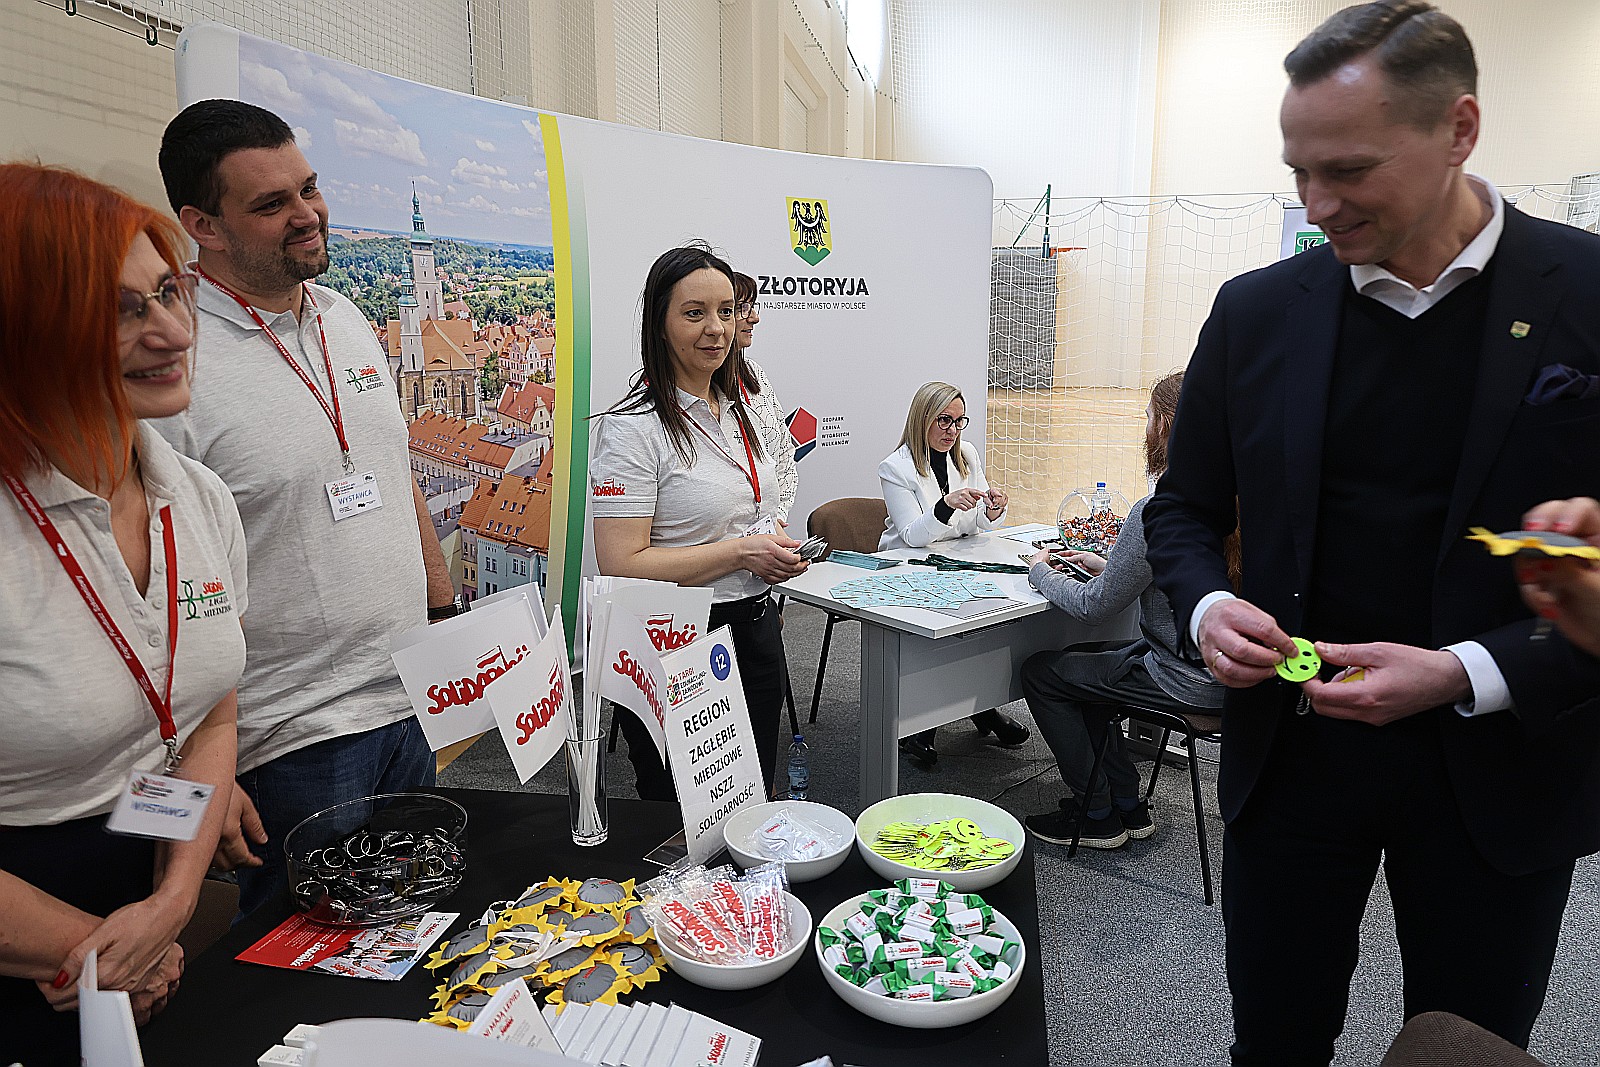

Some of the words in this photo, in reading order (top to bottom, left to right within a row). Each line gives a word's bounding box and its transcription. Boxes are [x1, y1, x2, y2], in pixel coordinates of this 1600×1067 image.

[758, 275, 869, 296] ZŁOTORYJA
[763, 302, 806, 310] NAJSTARSZE
[807, 302, 832, 310] MIASTO
[833, 302, 840, 310] W
[841, 302, 866, 310] POLSCE
[338, 489, 373, 504] WYSTAWCA
[715, 654, 727, 671] 12
[678, 667, 694, 681] TARGI
[682, 679, 705, 695] ZAWODOWE
[683, 696, 731, 737] REGION
[689, 723, 737, 765] ZAGŁĘBIE
[693, 745, 743, 787] MIEDZIOWE
[709, 775, 735, 803] NSZZ
